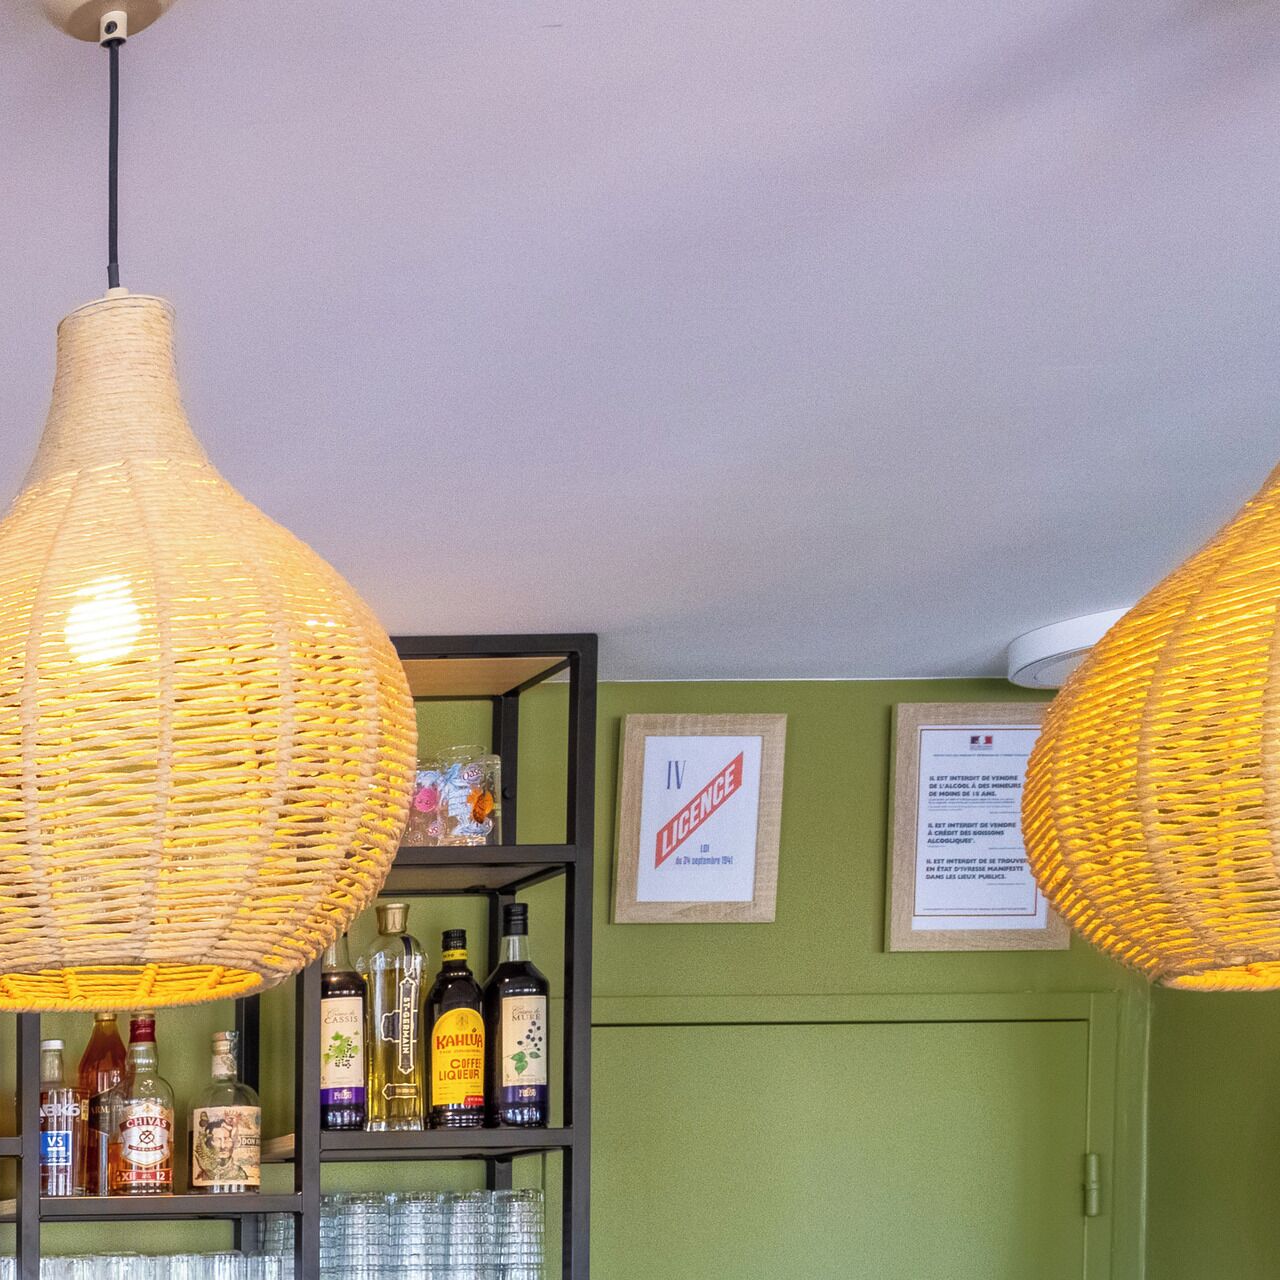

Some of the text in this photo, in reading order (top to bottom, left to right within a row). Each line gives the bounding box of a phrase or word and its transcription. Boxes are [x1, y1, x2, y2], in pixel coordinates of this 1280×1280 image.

[667, 760, 686, 790] IV
[661, 763, 737, 857] LICENCE
[324, 1016, 359, 1025] CASSIS
[439, 1070, 480, 1081] LIQUEUR
[126, 1116, 167, 1128] CHIVAS
[47, 1136, 63, 1147] VS
